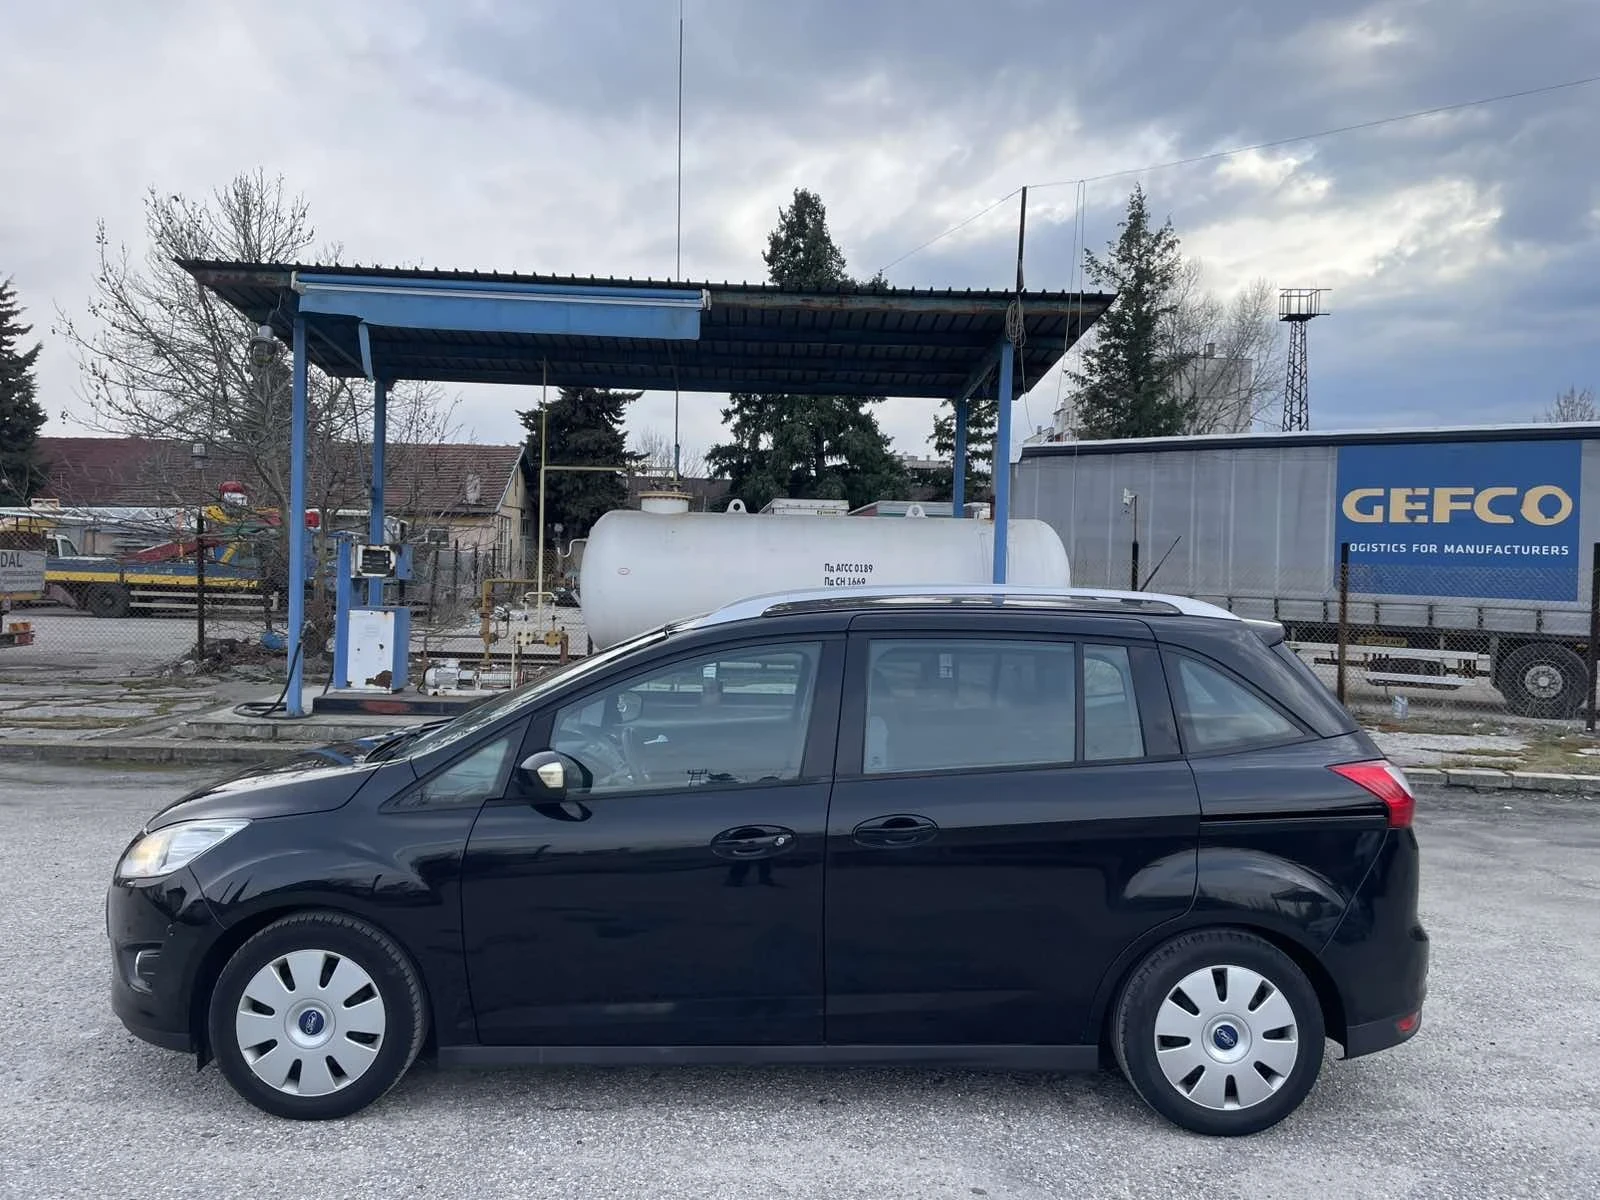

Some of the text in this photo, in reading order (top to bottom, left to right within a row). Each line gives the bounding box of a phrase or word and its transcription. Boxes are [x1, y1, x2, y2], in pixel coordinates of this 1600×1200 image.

[1342, 485, 1573, 526] GEFCO
[1346, 543, 1569, 556] OGISTICS FOR MANUFACTURERS
[854, 564, 873, 573] 0189
